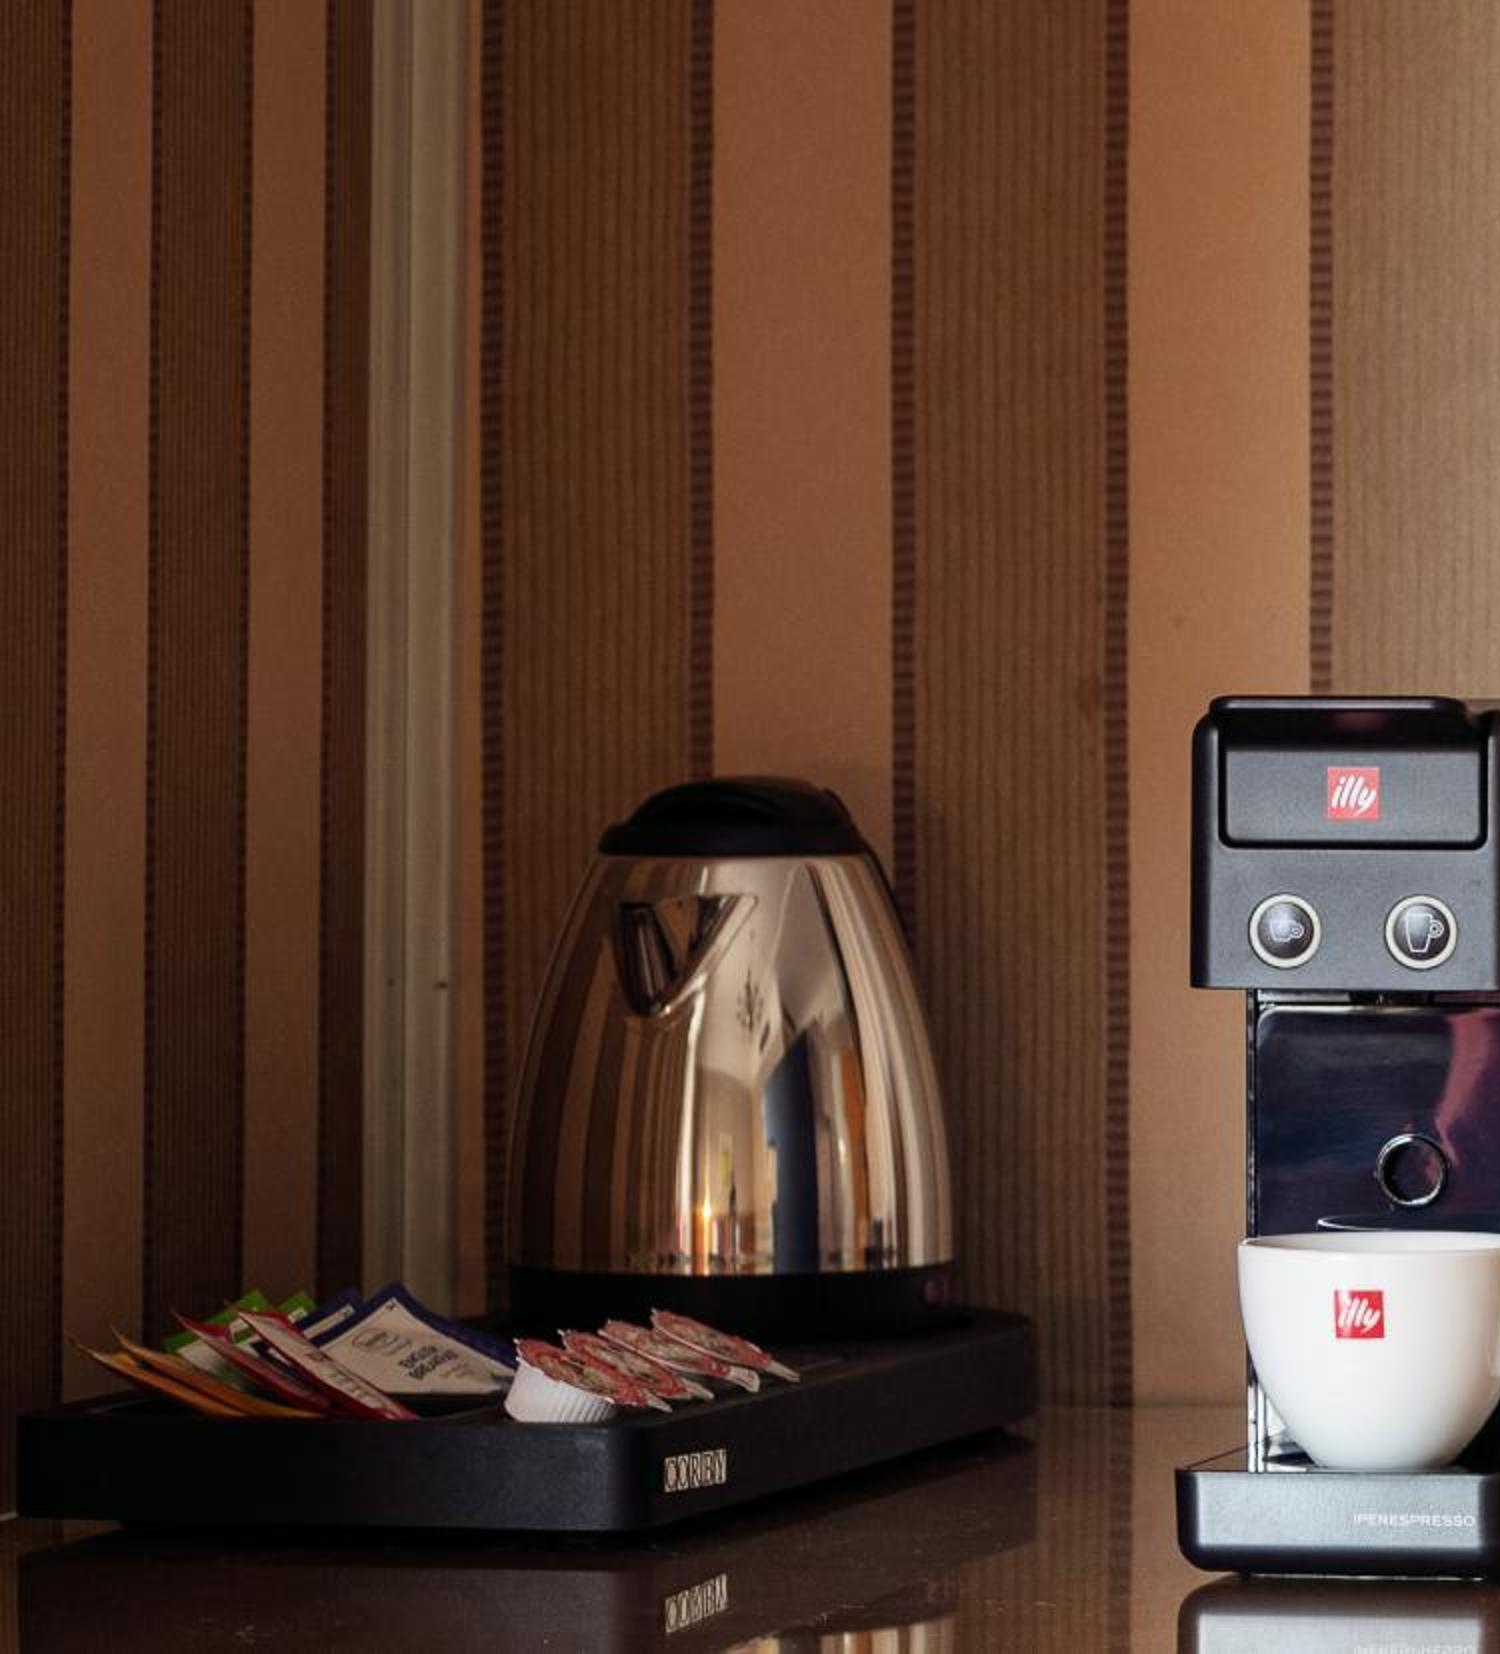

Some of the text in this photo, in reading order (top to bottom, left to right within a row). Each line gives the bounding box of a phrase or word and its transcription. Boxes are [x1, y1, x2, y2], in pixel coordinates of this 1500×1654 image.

[1331, 775, 1377, 816] illy
[1338, 1294, 1380, 1335] illy
[664, 1449, 727, 1493] CORBY
[1353, 1513, 1476, 1527] IPERESPRESSO
